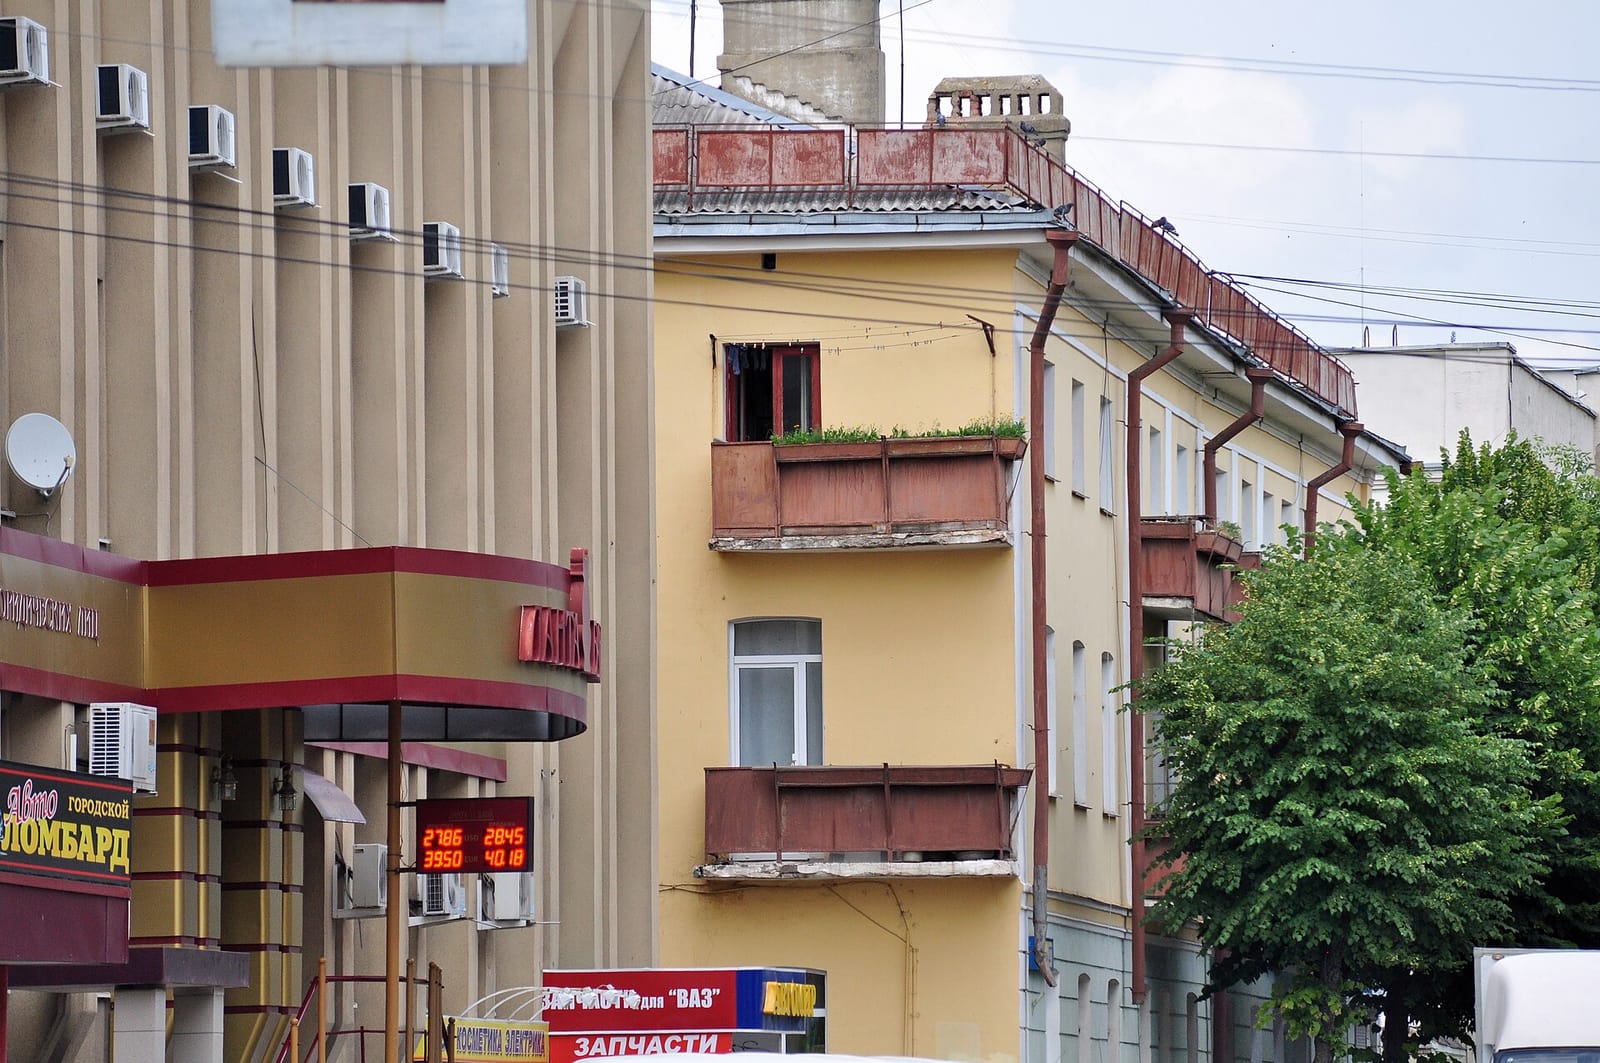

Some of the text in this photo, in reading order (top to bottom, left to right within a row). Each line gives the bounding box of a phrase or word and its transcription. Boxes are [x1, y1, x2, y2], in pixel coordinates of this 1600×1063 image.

[68, 796, 129, 819] ГОРОДСКОЙ
[1, 812, 130, 874] ЛОМБАРД
[640, 996, 664, 1010] для
[456, 1026, 502, 1053] КОСМЕТИКА
[505, 1029, 545, 1055] ЭЛЕКТРИКА
[574, 1034, 718, 1057] ЗАПЧАСТИ
